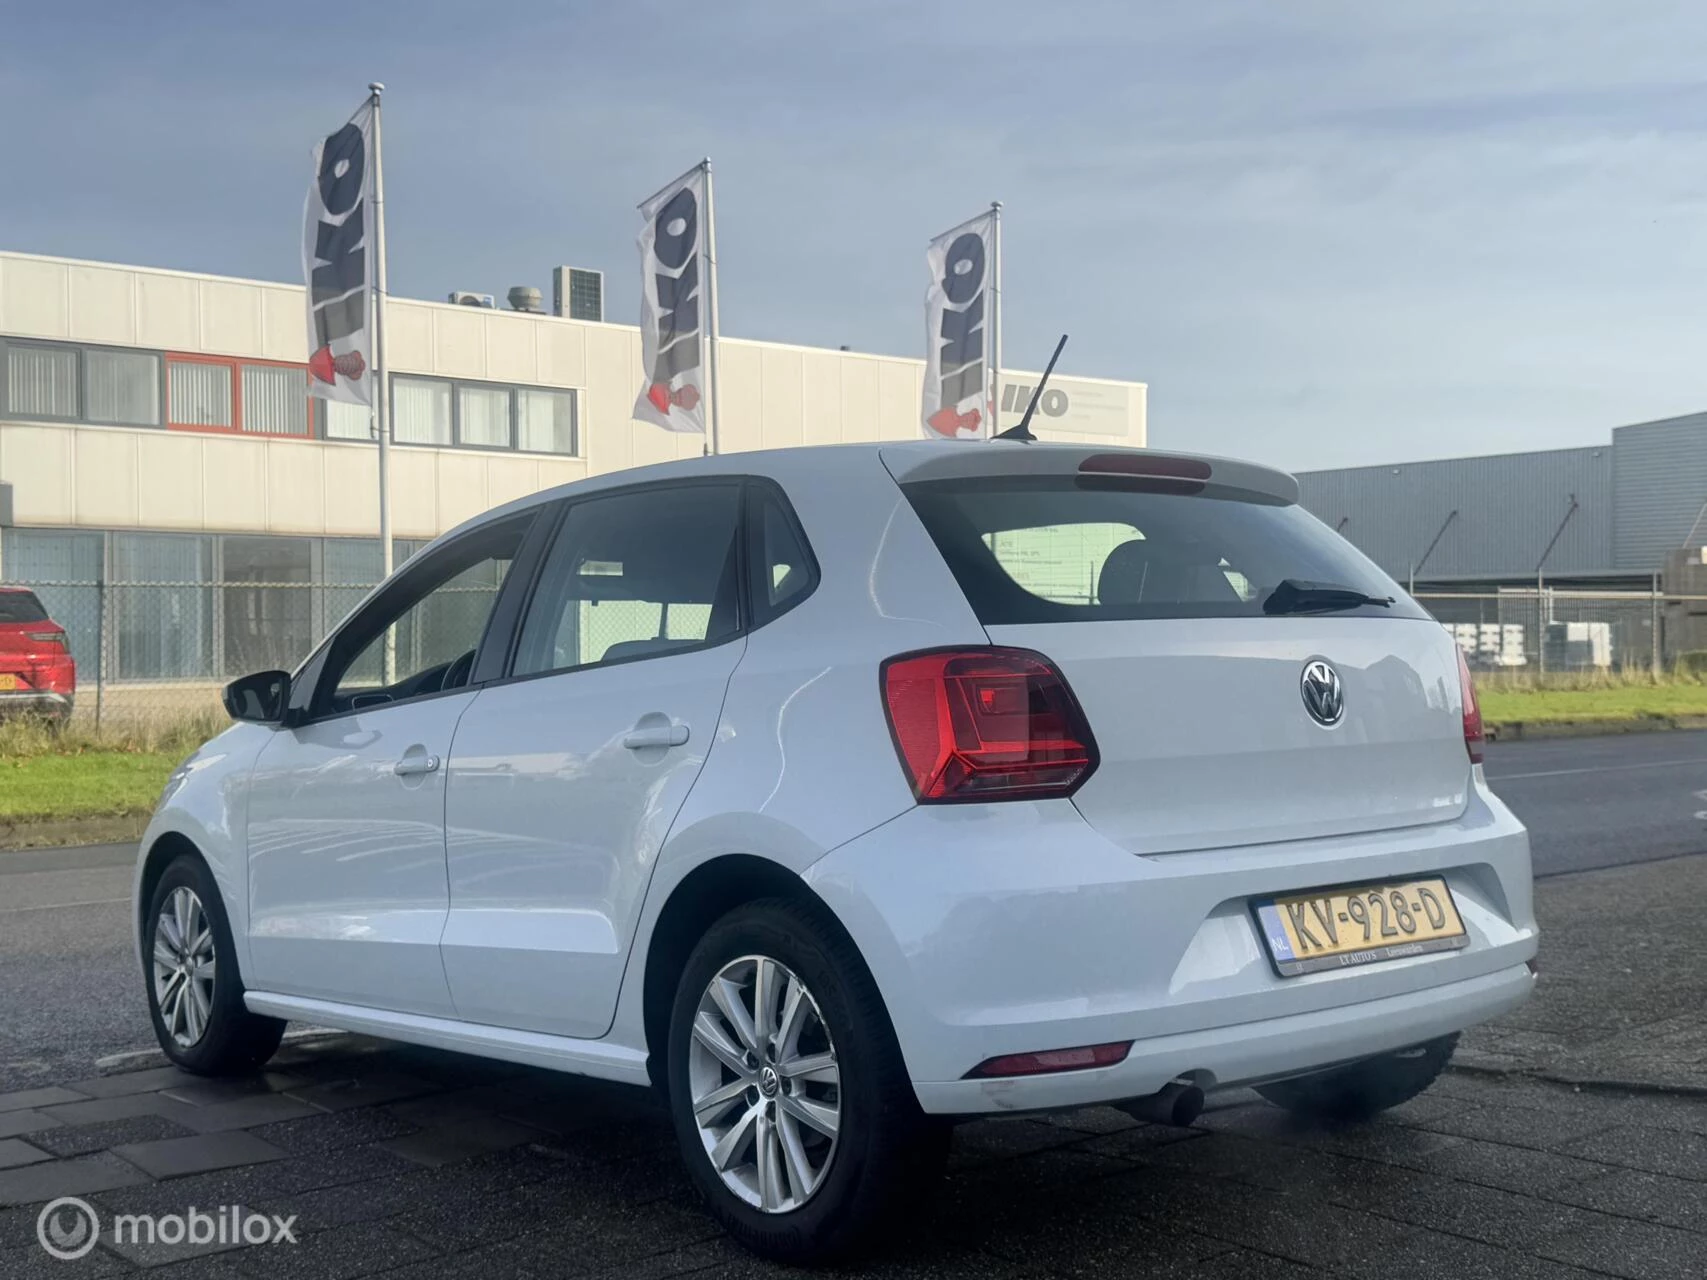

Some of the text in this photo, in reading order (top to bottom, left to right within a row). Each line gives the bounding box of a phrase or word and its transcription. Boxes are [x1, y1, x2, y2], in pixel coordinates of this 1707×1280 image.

[1001, 383, 1069, 418] IKO
[1286, 887, 1446, 951] KV-928-D
[1271, 936, 1289, 952] NL
